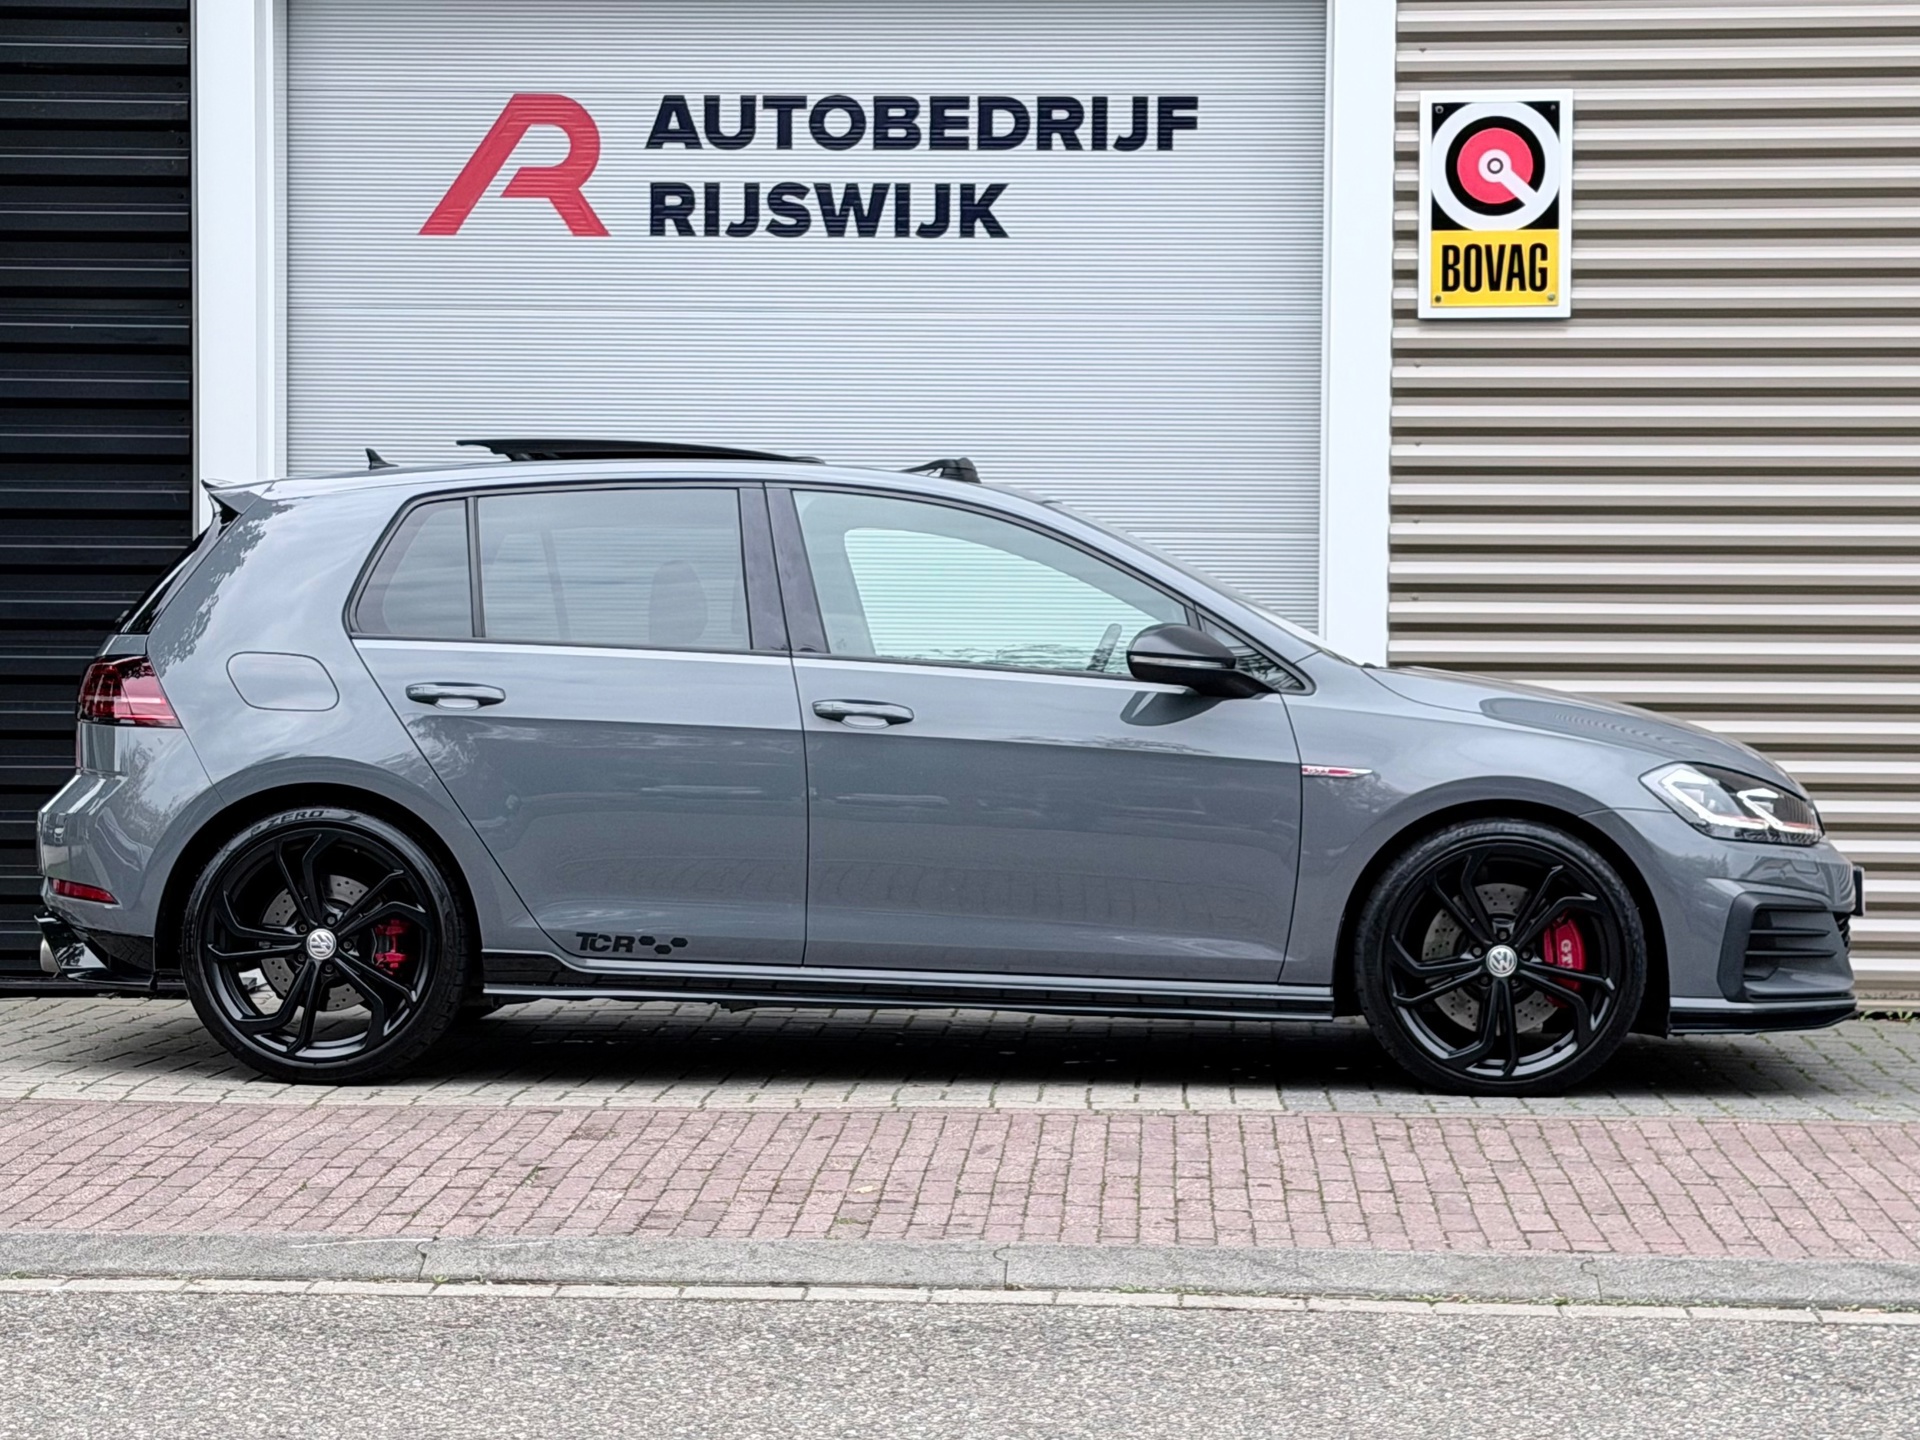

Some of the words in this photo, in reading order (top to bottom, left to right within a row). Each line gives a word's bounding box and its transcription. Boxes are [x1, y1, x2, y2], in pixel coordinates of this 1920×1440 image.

[646, 94, 1199, 151] AUTOBEDRIJF
[649, 182, 1009, 238] RIJSWIJK
[1441, 243, 1548, 292] BOVAG
[267, 810, 325, 829] ZERO
[576, 931, 636, 953] TCR
